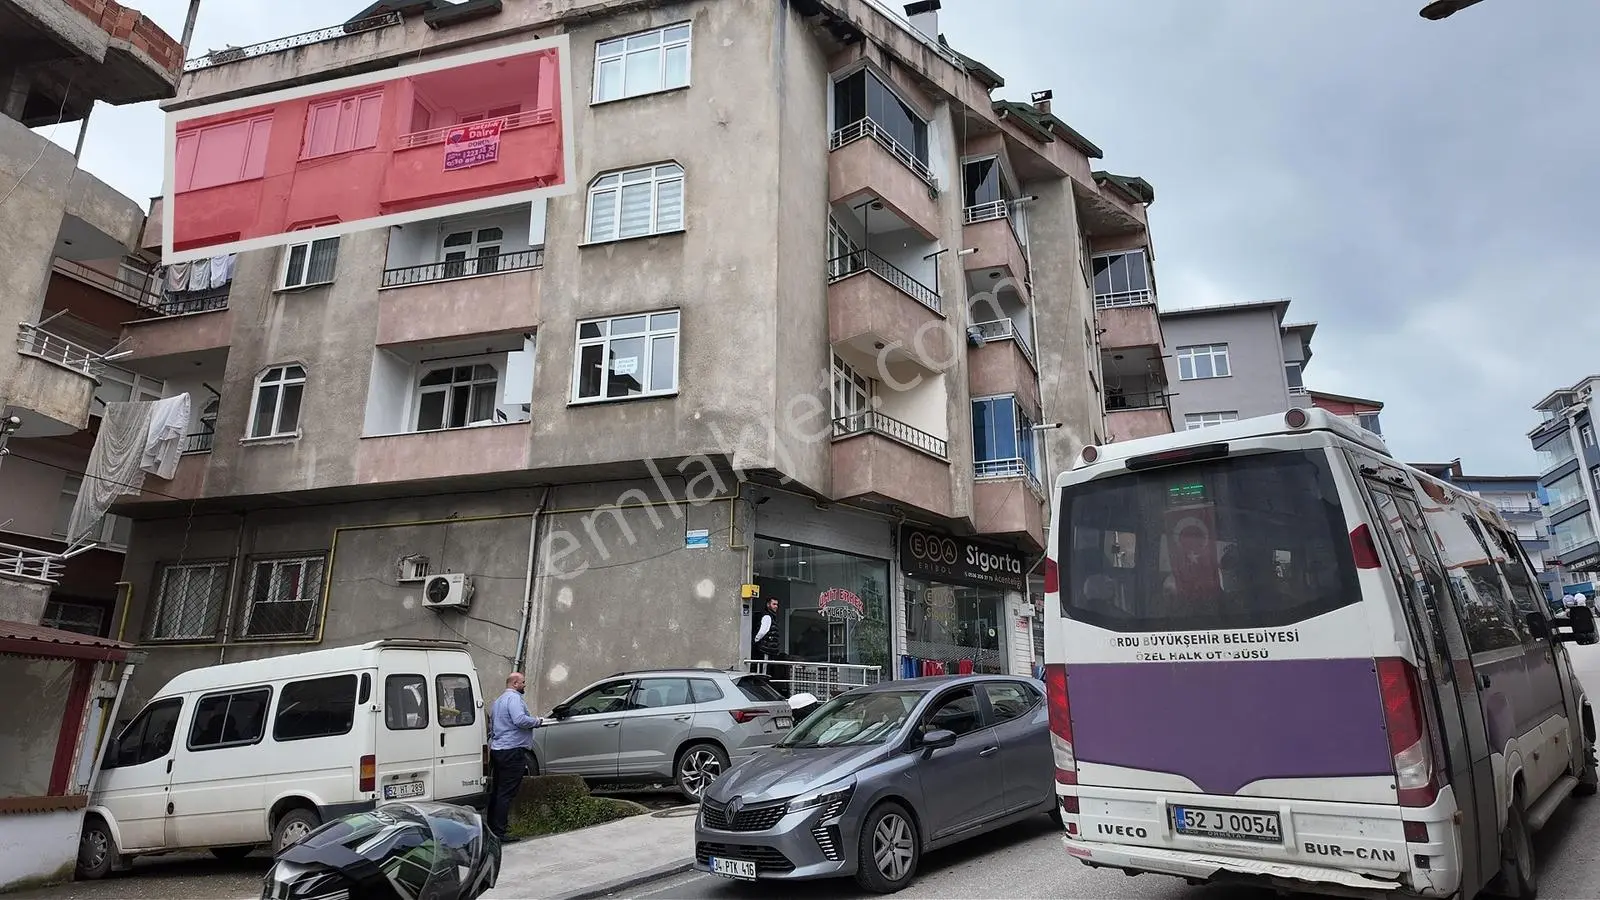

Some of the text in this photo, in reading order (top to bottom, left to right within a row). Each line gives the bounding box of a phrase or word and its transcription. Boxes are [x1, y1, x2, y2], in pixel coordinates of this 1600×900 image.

[912, 537, 1021, 574] EDA Sigorta
[1143, 631, 1219, 648] BÜYÜKŞEHİR
[1224, 629, 1300, 645] BELEDİYESİ
[1136, 651, 1166, 661] ÖZEL
[1169, 651, 1203, 661] HALK
[389, 783, 423, 796] 52 HT 289
[1097, 823, 1148, 839] IVECO
[1184, 811, 1277, 835] 52 J 0054
[1304, 842, 1396, 862] BUR-CAN
[713, 858, 755, 876] 34 PTK 416
